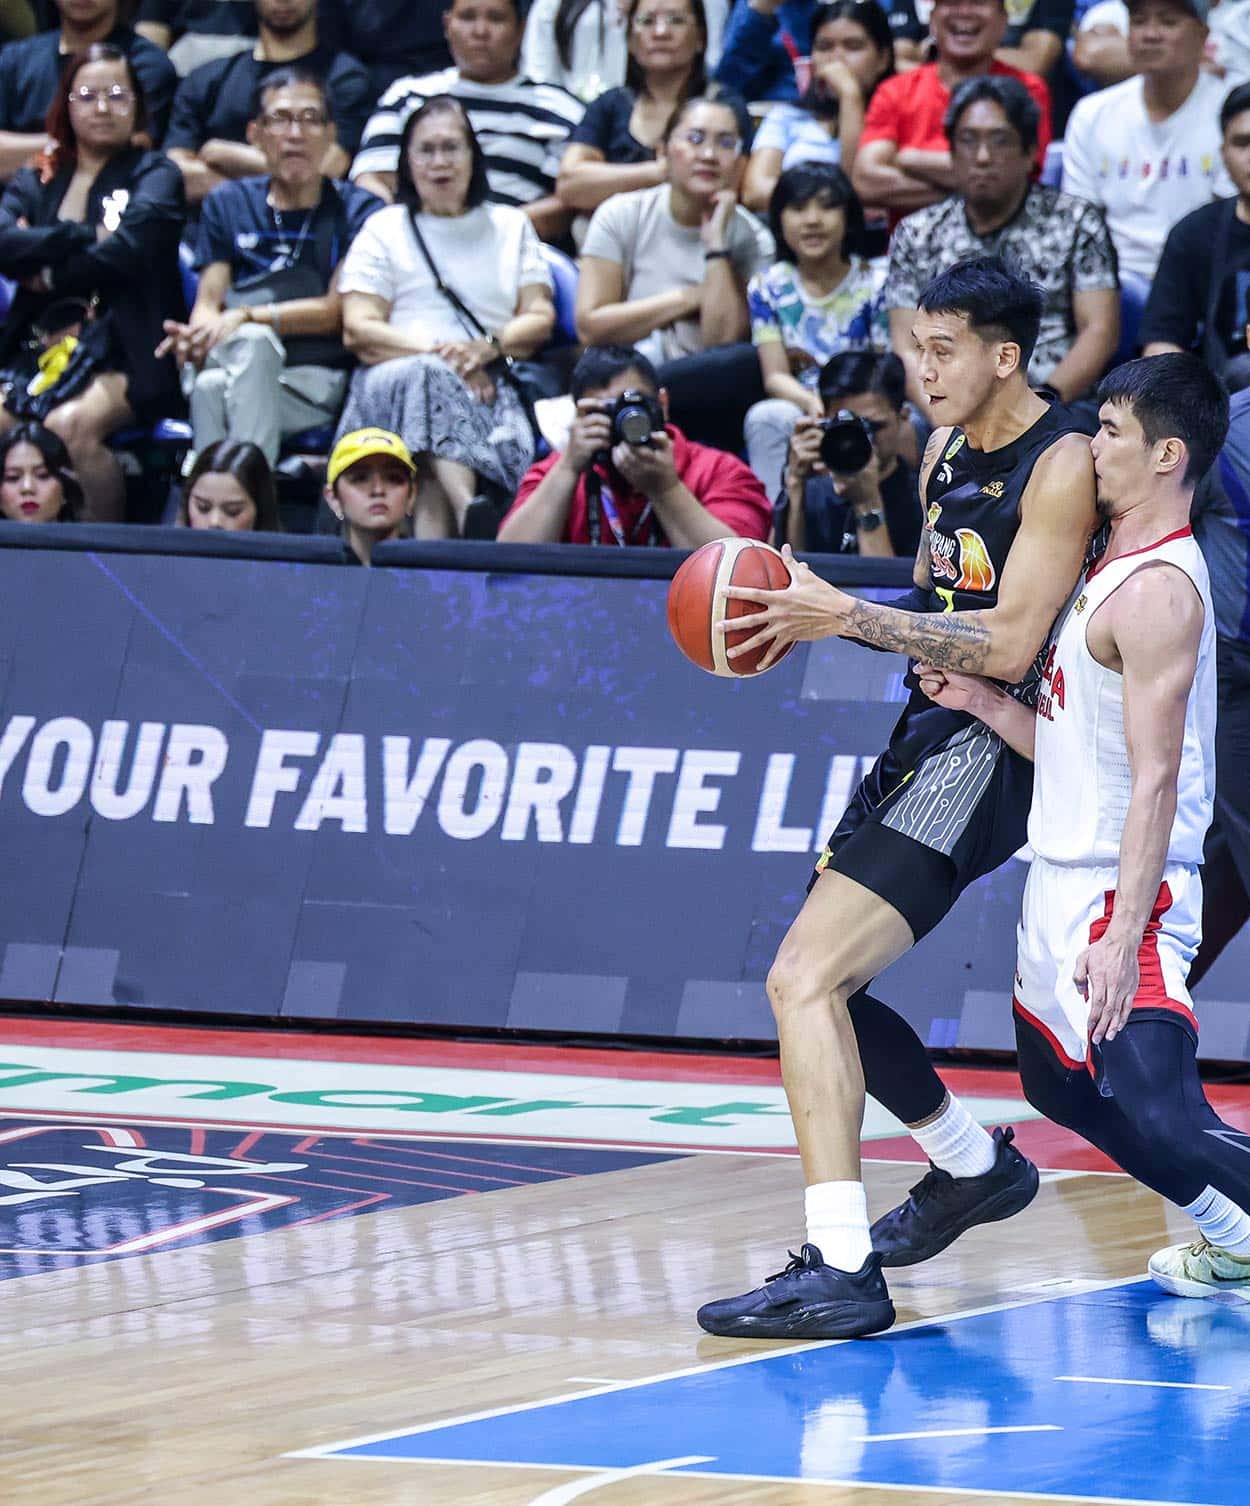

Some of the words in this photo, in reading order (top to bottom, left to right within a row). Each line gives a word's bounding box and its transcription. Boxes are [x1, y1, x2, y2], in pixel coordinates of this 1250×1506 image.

[0, 716, 229, 825] YOUR
[244, 728, 740, 852] FAVORITE
[751, 752, 880, 854] LI
